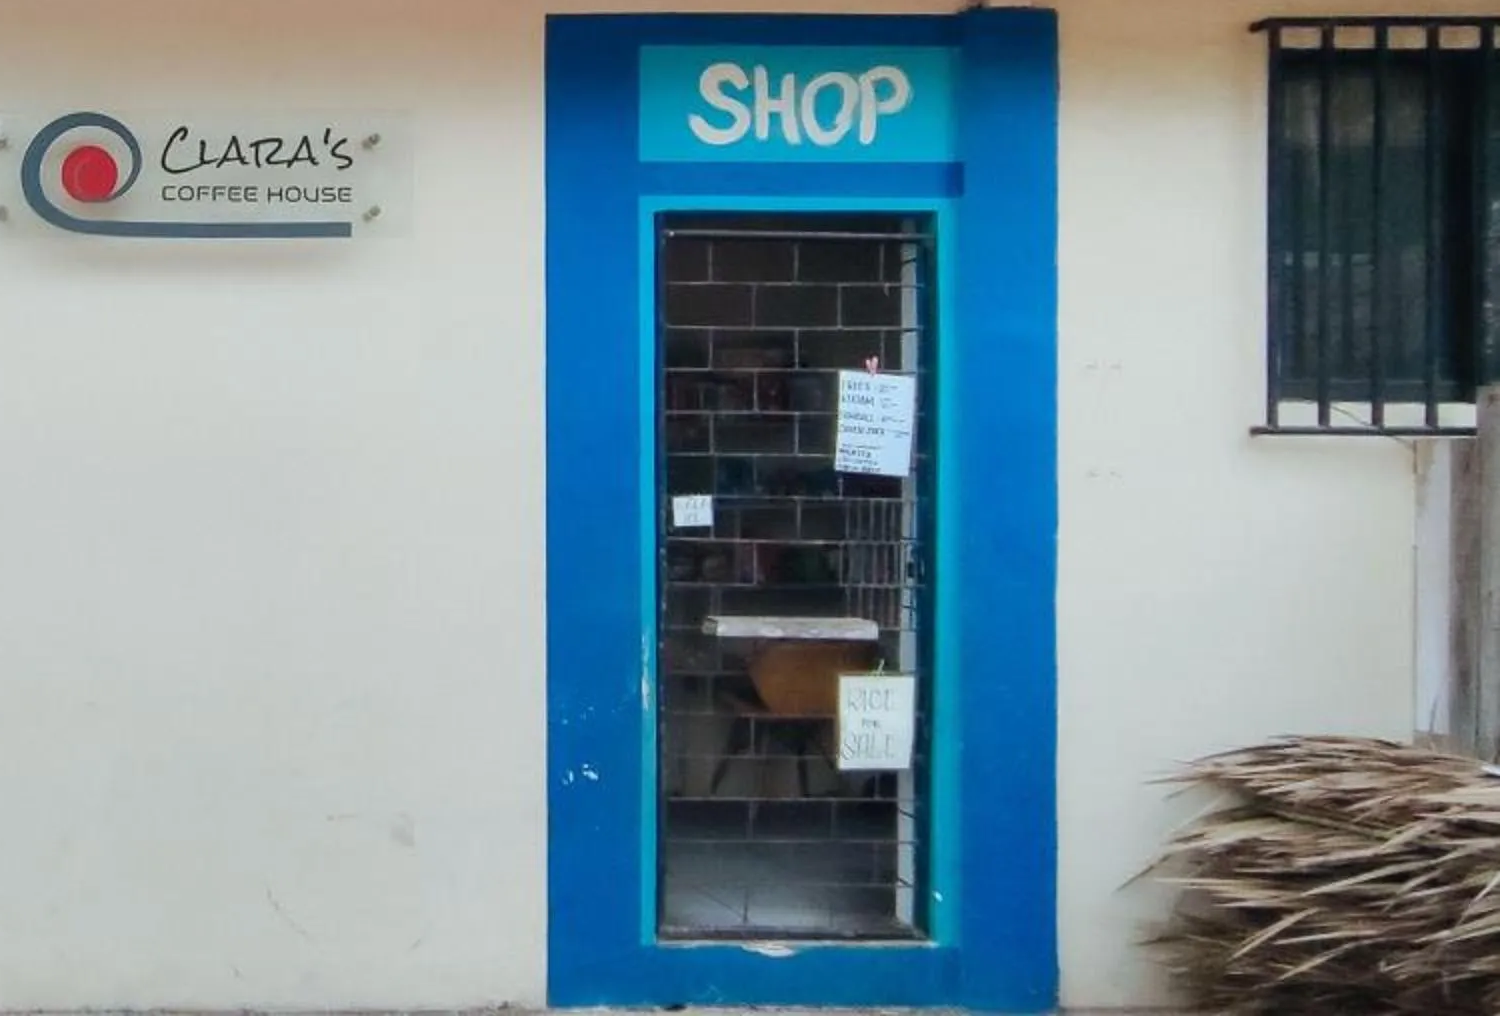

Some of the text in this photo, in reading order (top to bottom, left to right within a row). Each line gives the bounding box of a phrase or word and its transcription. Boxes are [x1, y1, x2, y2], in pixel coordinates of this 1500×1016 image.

[687, 62, 913, 147] SHOP
[161, 185, 353, 204] COFFEE HOUSE
